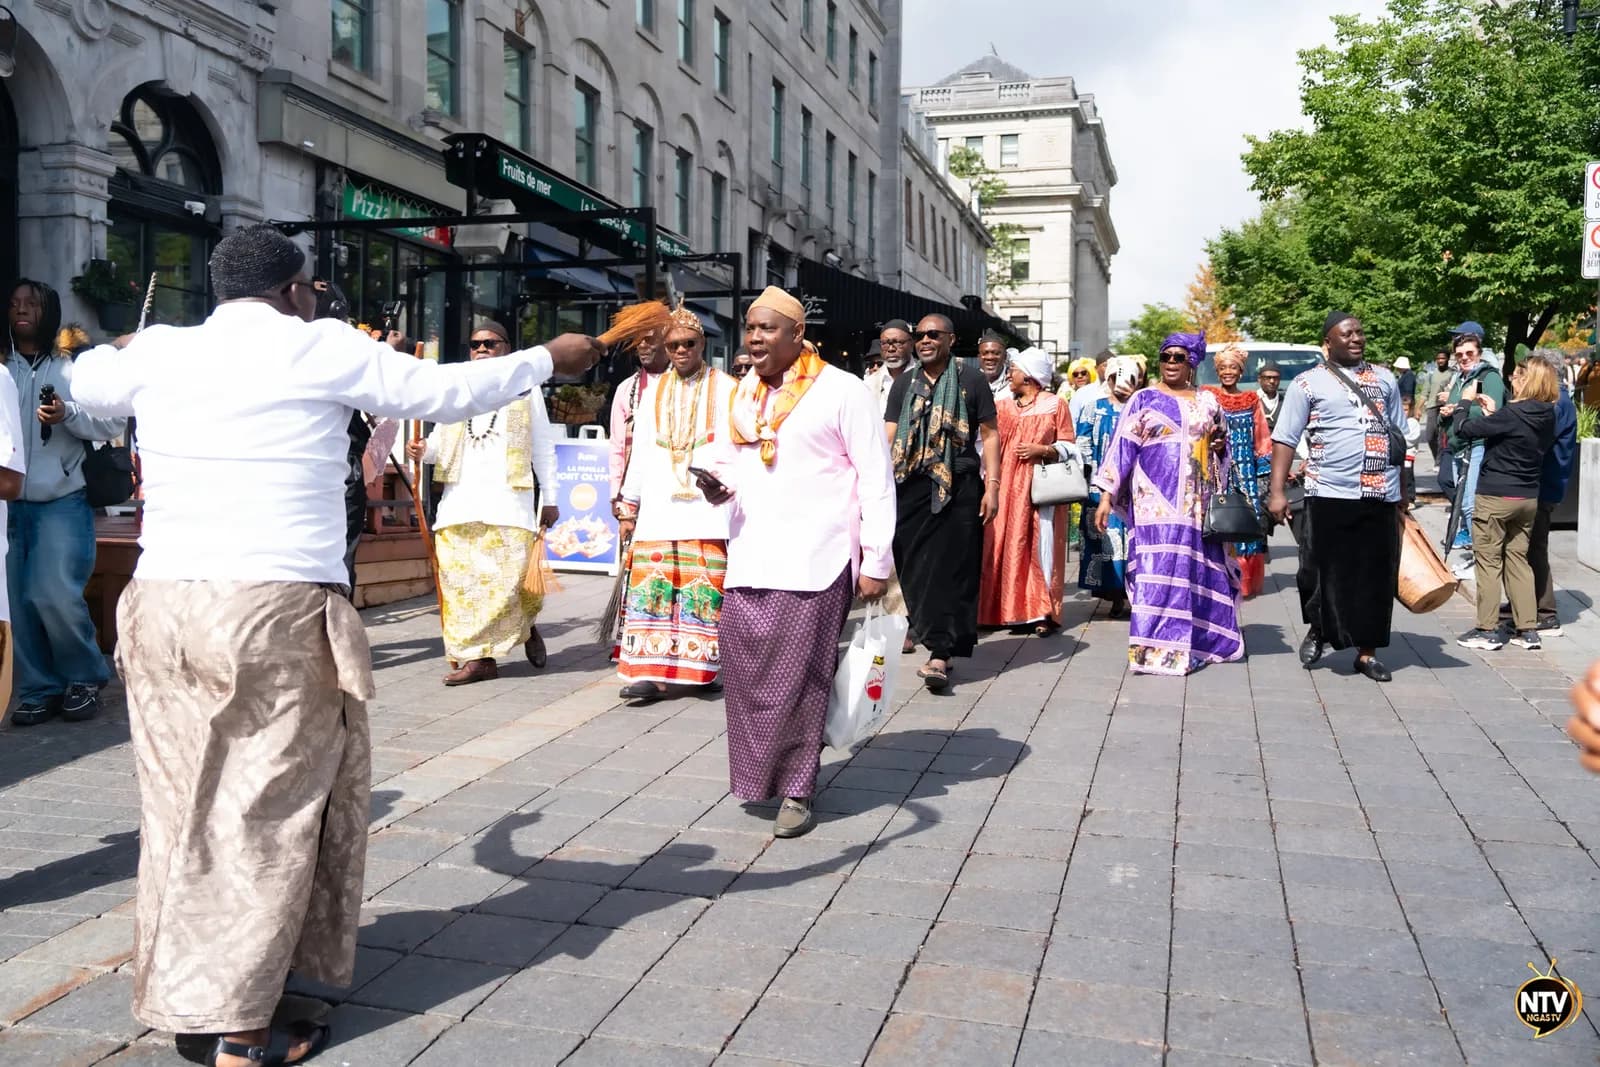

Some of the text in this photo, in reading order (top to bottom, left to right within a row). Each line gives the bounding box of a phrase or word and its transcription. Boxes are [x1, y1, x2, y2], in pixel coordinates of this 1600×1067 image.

[503, 158, 552, 196] Fruits de mer
[352, 188, 392, 220] Pizza
[556, 472, 580, 481] ONT
